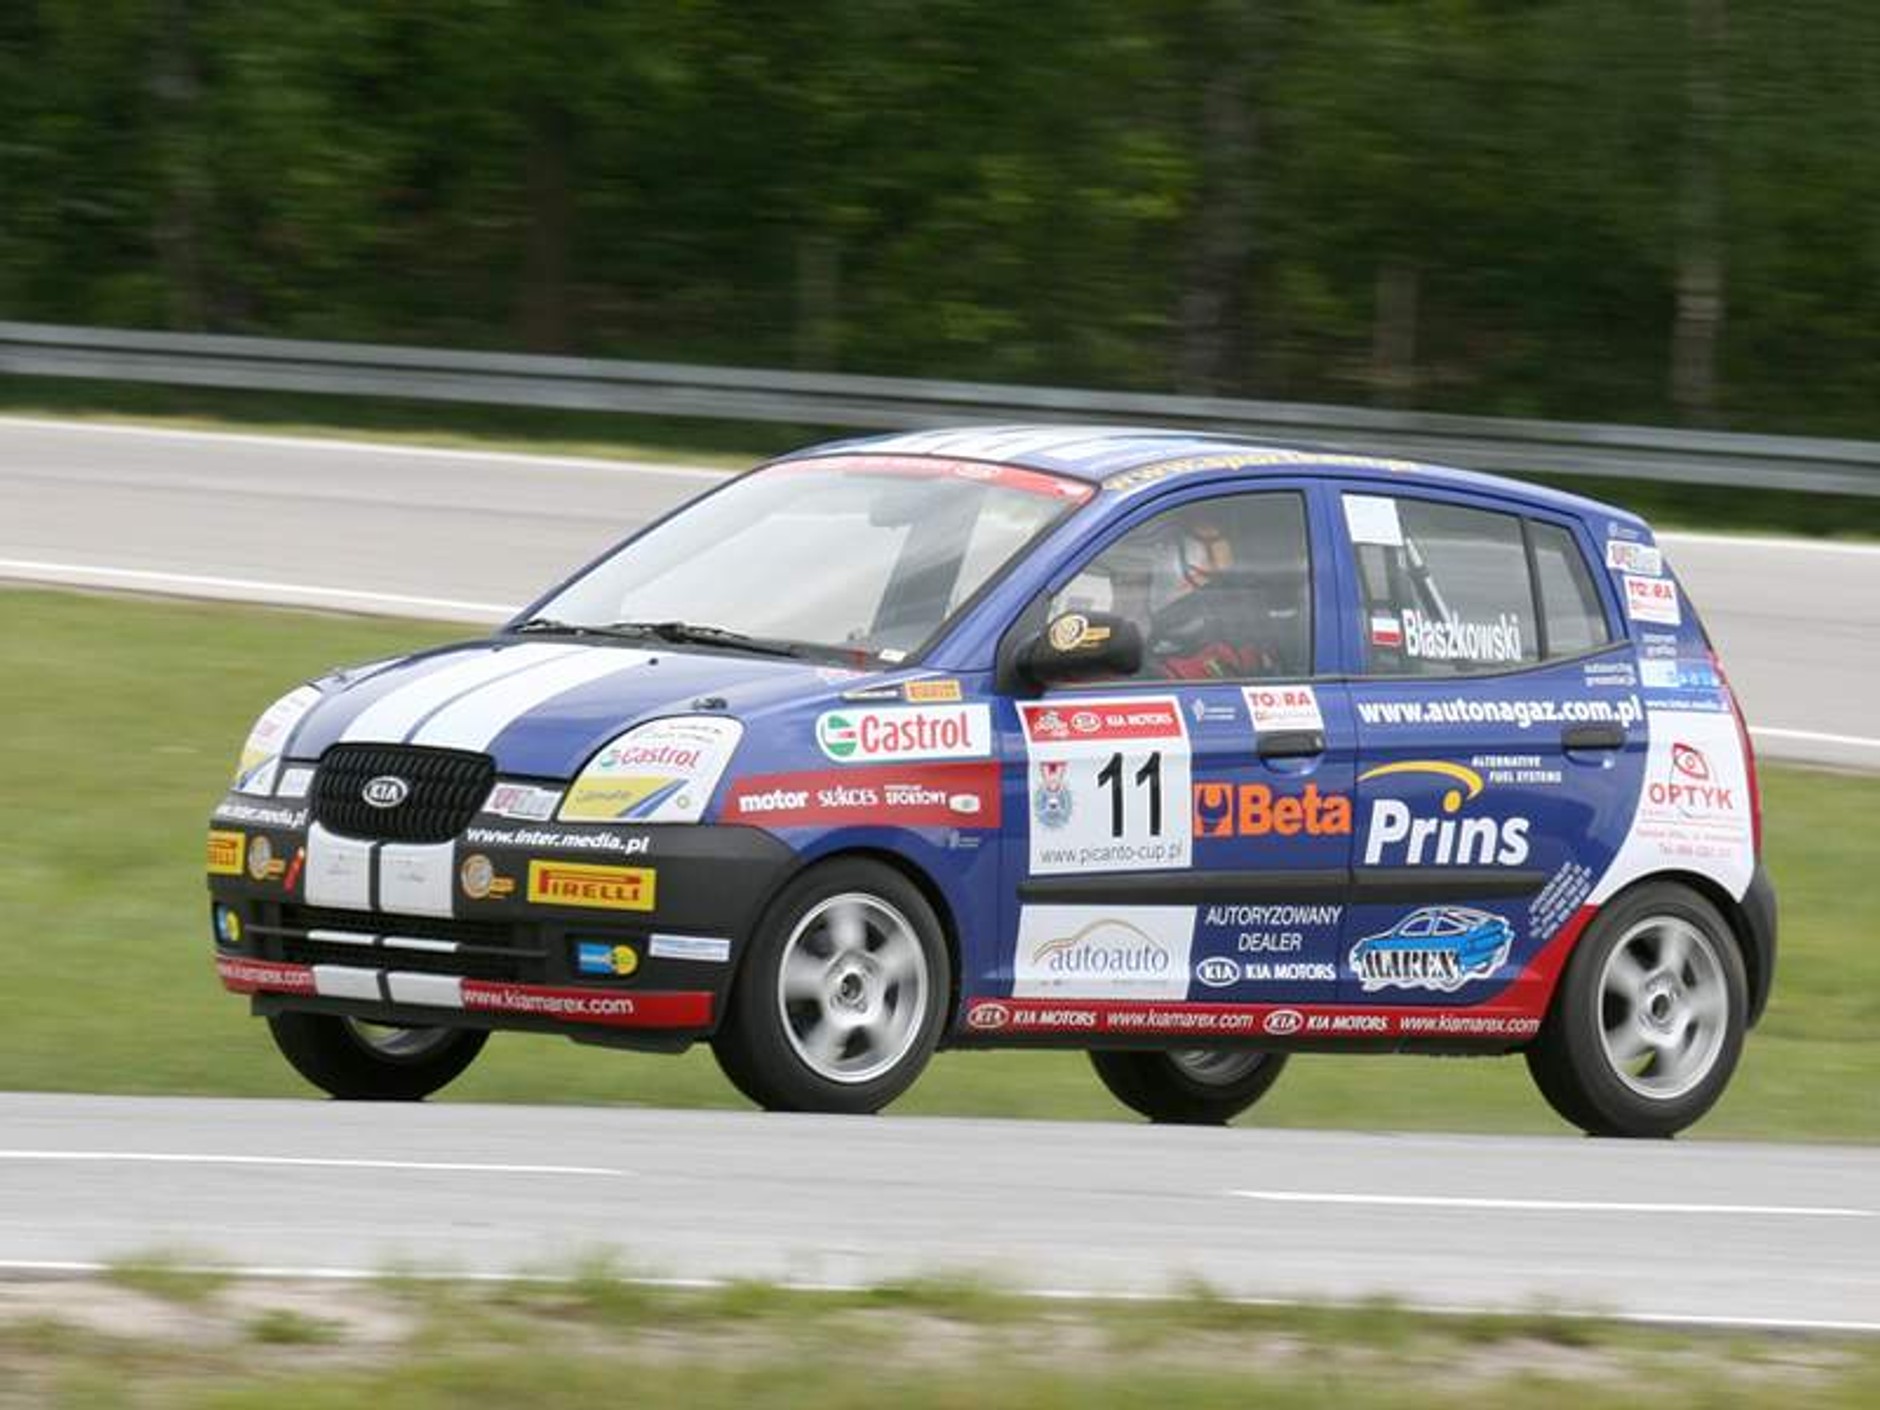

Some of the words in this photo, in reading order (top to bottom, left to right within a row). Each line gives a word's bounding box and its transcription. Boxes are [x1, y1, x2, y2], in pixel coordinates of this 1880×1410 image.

[1401, 608, 1523, 662] Błaszkowski
[1357, 695, 1643, 728] www.autonagaz.com.pl
[860, 711, 972, 754] Castrol
[620, 744, 701, 769] Castrol
[368, 783, 400, 800] KIA
[738, 788, 810, 814] motor
[1097, 751, 1162, 838] 11
[1648, 781, 1734, 810] OPTYK
[1238, 781, 1353, 837] Beta
[466, 827, 651, 855] www.inter.media.pl
[1362, 790, 1531, 867] Prins
[1039, 840, 1183, 866] www.picanto-cup.pl
[537, 868, 643, 901] PIRELLI
[1204, 904, 1344, 927] AUTORYZOWANY
[1237, 931, 1303, 952] DEALER
[1049, 946, 1170, 974] autoauto
[1203, 963, 1235, 981] KIA
[1245, 963, 1272, 981] KIA
[1273, 962, 1337, 981] MOTORS
[1012, 1008, 1038, 1025] KIA
[1039, 1009, 1098, 1027] MOTORS
[1306, 1014, 1331, 1030] KIA
[1331, 1015, 1389, 1032] MOTORS
